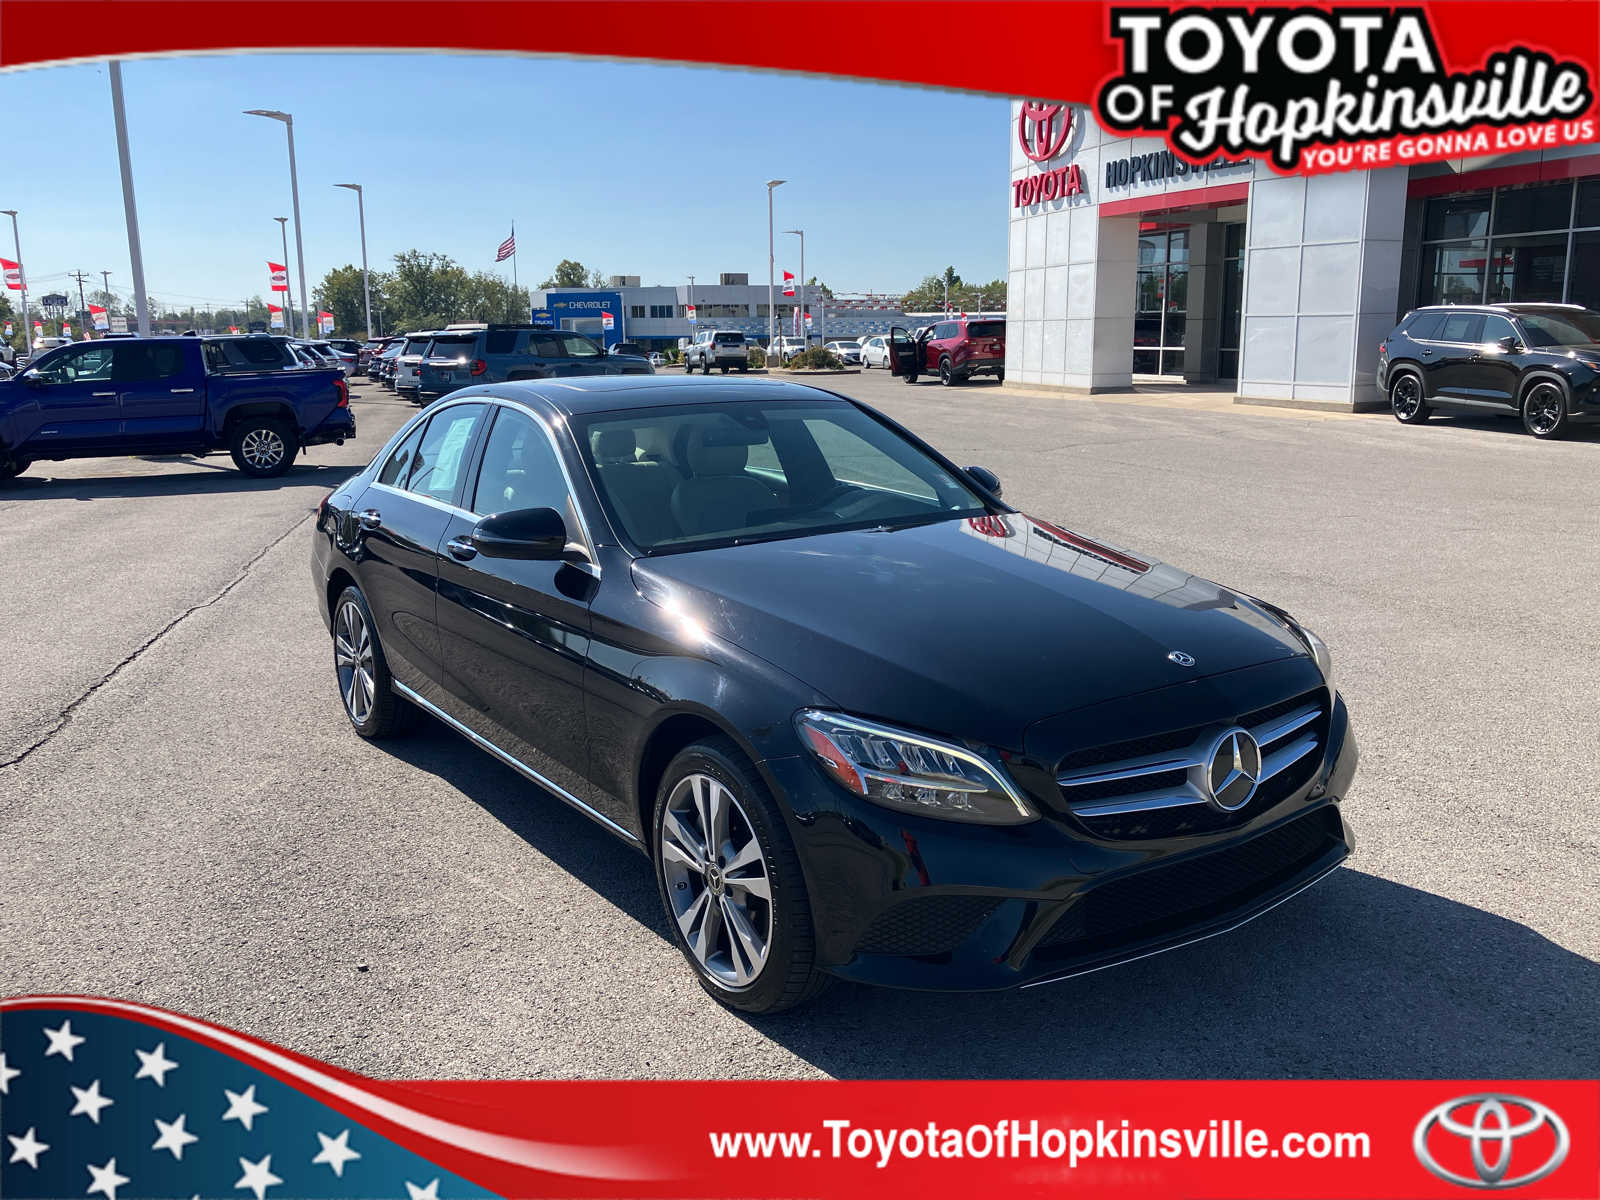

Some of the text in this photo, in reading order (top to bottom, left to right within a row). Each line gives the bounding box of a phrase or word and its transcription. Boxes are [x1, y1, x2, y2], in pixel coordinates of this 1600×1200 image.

[1012, 164, 1083, 209] TOYOTA
[1106, 150, 1250, 188] HOPKINS
[568, 301, 611, 309] CHEVROLET
